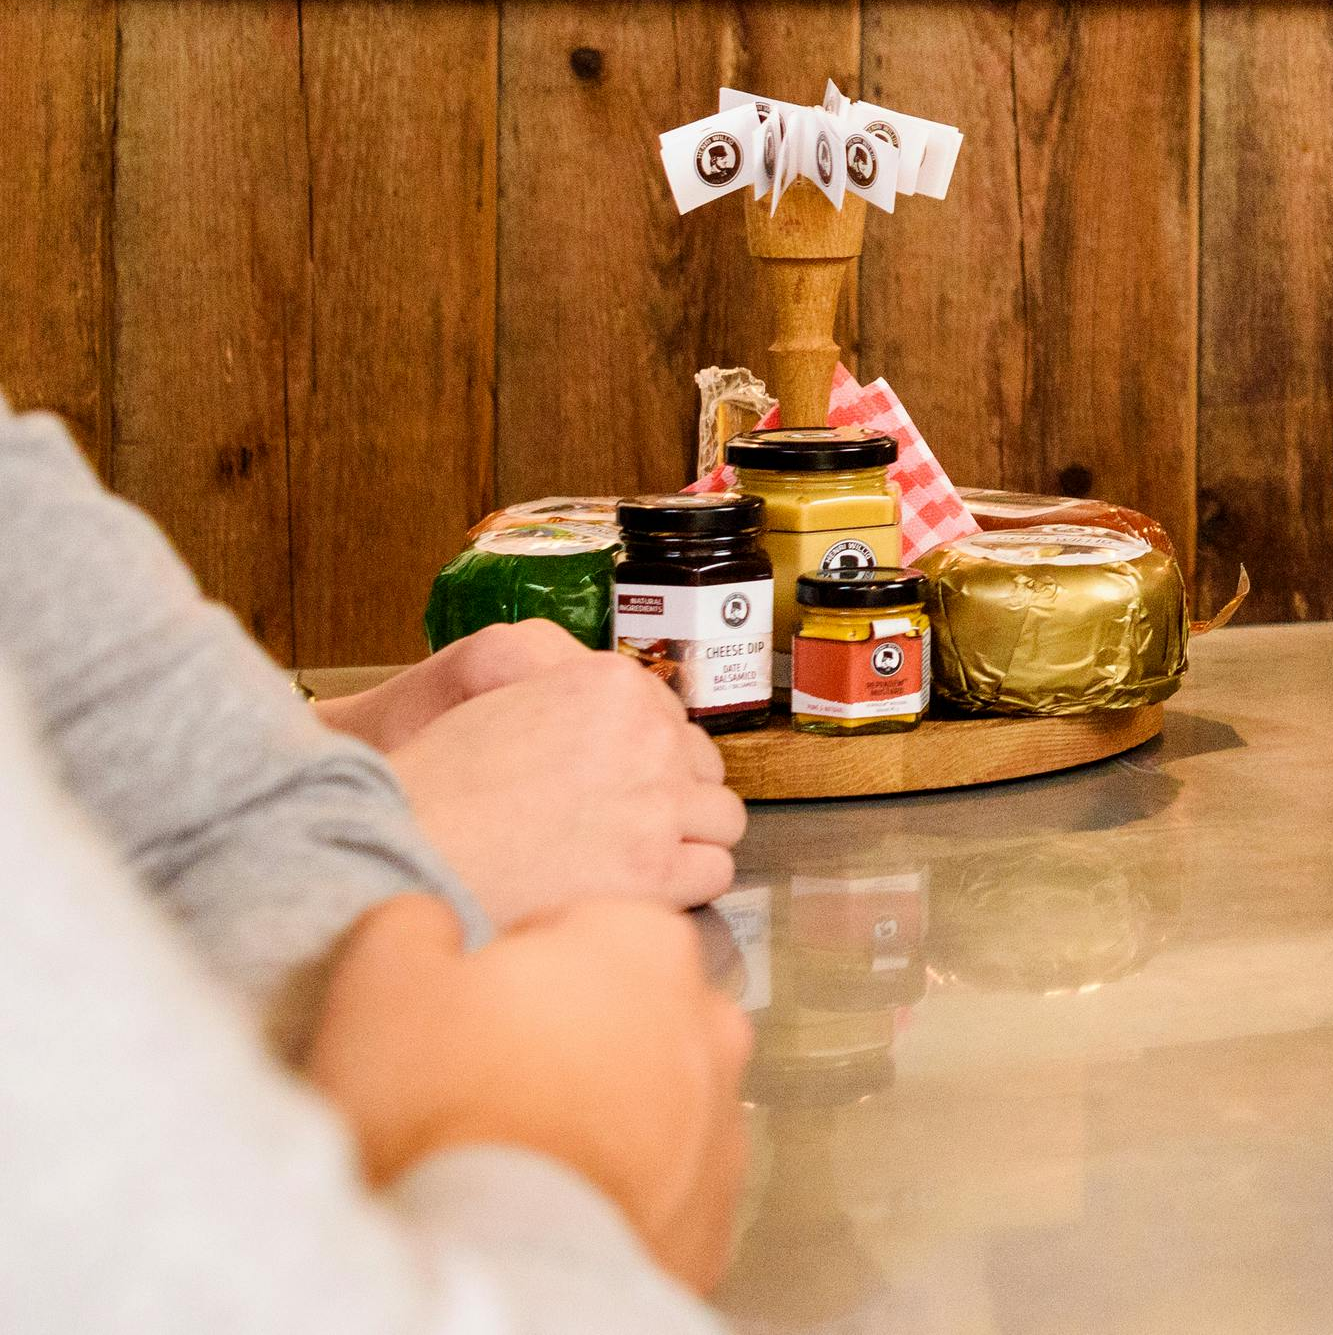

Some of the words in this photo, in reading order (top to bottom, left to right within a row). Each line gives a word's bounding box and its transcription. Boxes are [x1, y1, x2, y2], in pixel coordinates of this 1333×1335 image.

[697, 138, 712, 159] HENRI
[824, 542, 847, 564] HENRI
[848, 541, 873, 560] WILLIG
[630, 597, 662, 606] NATURAL
[619, 604, 663, 613] INGREDIENTS
[706, 643, 744, 660] CHEESE
[747, 641, 765, 654] DIP
[723, 663, 741, 674] DATE
[714, 671, 757, 684] BALSAMICO
